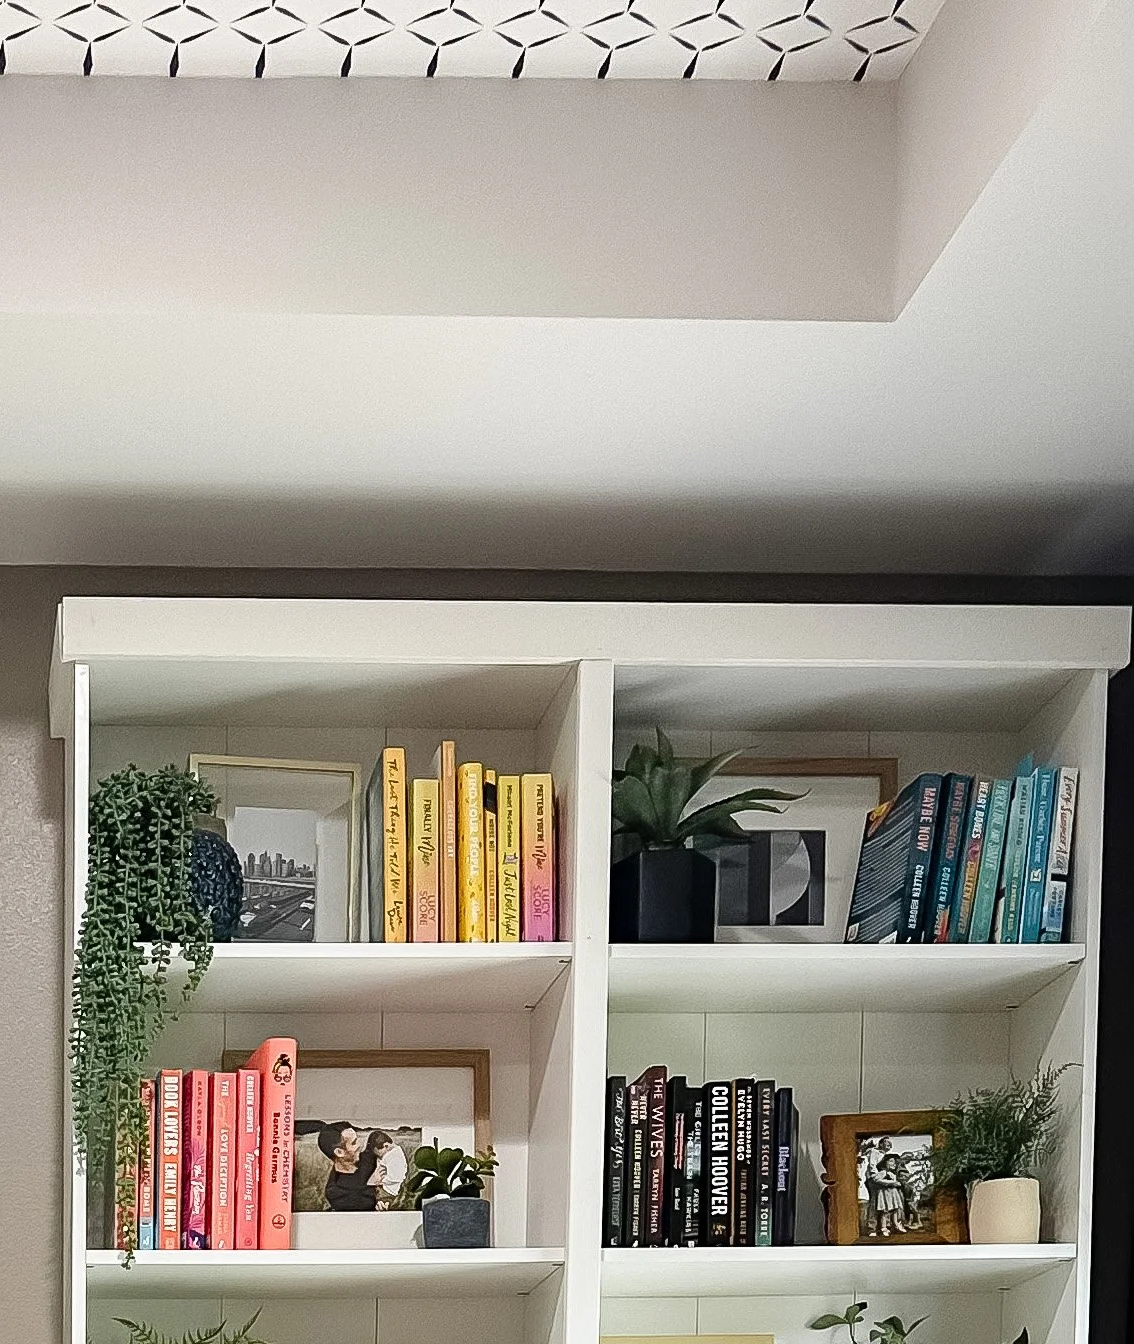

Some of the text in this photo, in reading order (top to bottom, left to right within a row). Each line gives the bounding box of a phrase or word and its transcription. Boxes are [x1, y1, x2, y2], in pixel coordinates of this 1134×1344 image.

[916, 788, 936, 851] MAYBE NOW
[971, 782, 989, 839] HEART BONES
[533, 885, 542, 920] SCORE
[541, 889, 550, 916] LUCY
[908, 865, 924, 929] COLLEEN HOOVER
[938, 867, 951, 901] COLLEEN
[963, 862, 975, 899] COLLEEN
[419, 890, 427, 925] SCORE
[427, 894, 435, 922] LUCY
[220, 1080, 229, 1097] THE
[737, 1090, 745, 1128] EVELYN
[163, 1076, 179, 1155] BOOK LOVERS
[283, 1094, 291, 1136] LESSONS
[650, 1078, 664, 1158] THE WIVES
[761, 1088, 770, 1176] EVERY LAST SECRET
[633, 1130, 642, 1160] COLLEEN
[711, 1086, 728, 1215] COLLEEN HOOVER
[777, 1146, 789, 1192] Blackout
[164, 1163, 178, 1232] EMILY HENRY
[651, 1169, 659, 1233] TARRYN FISHER
